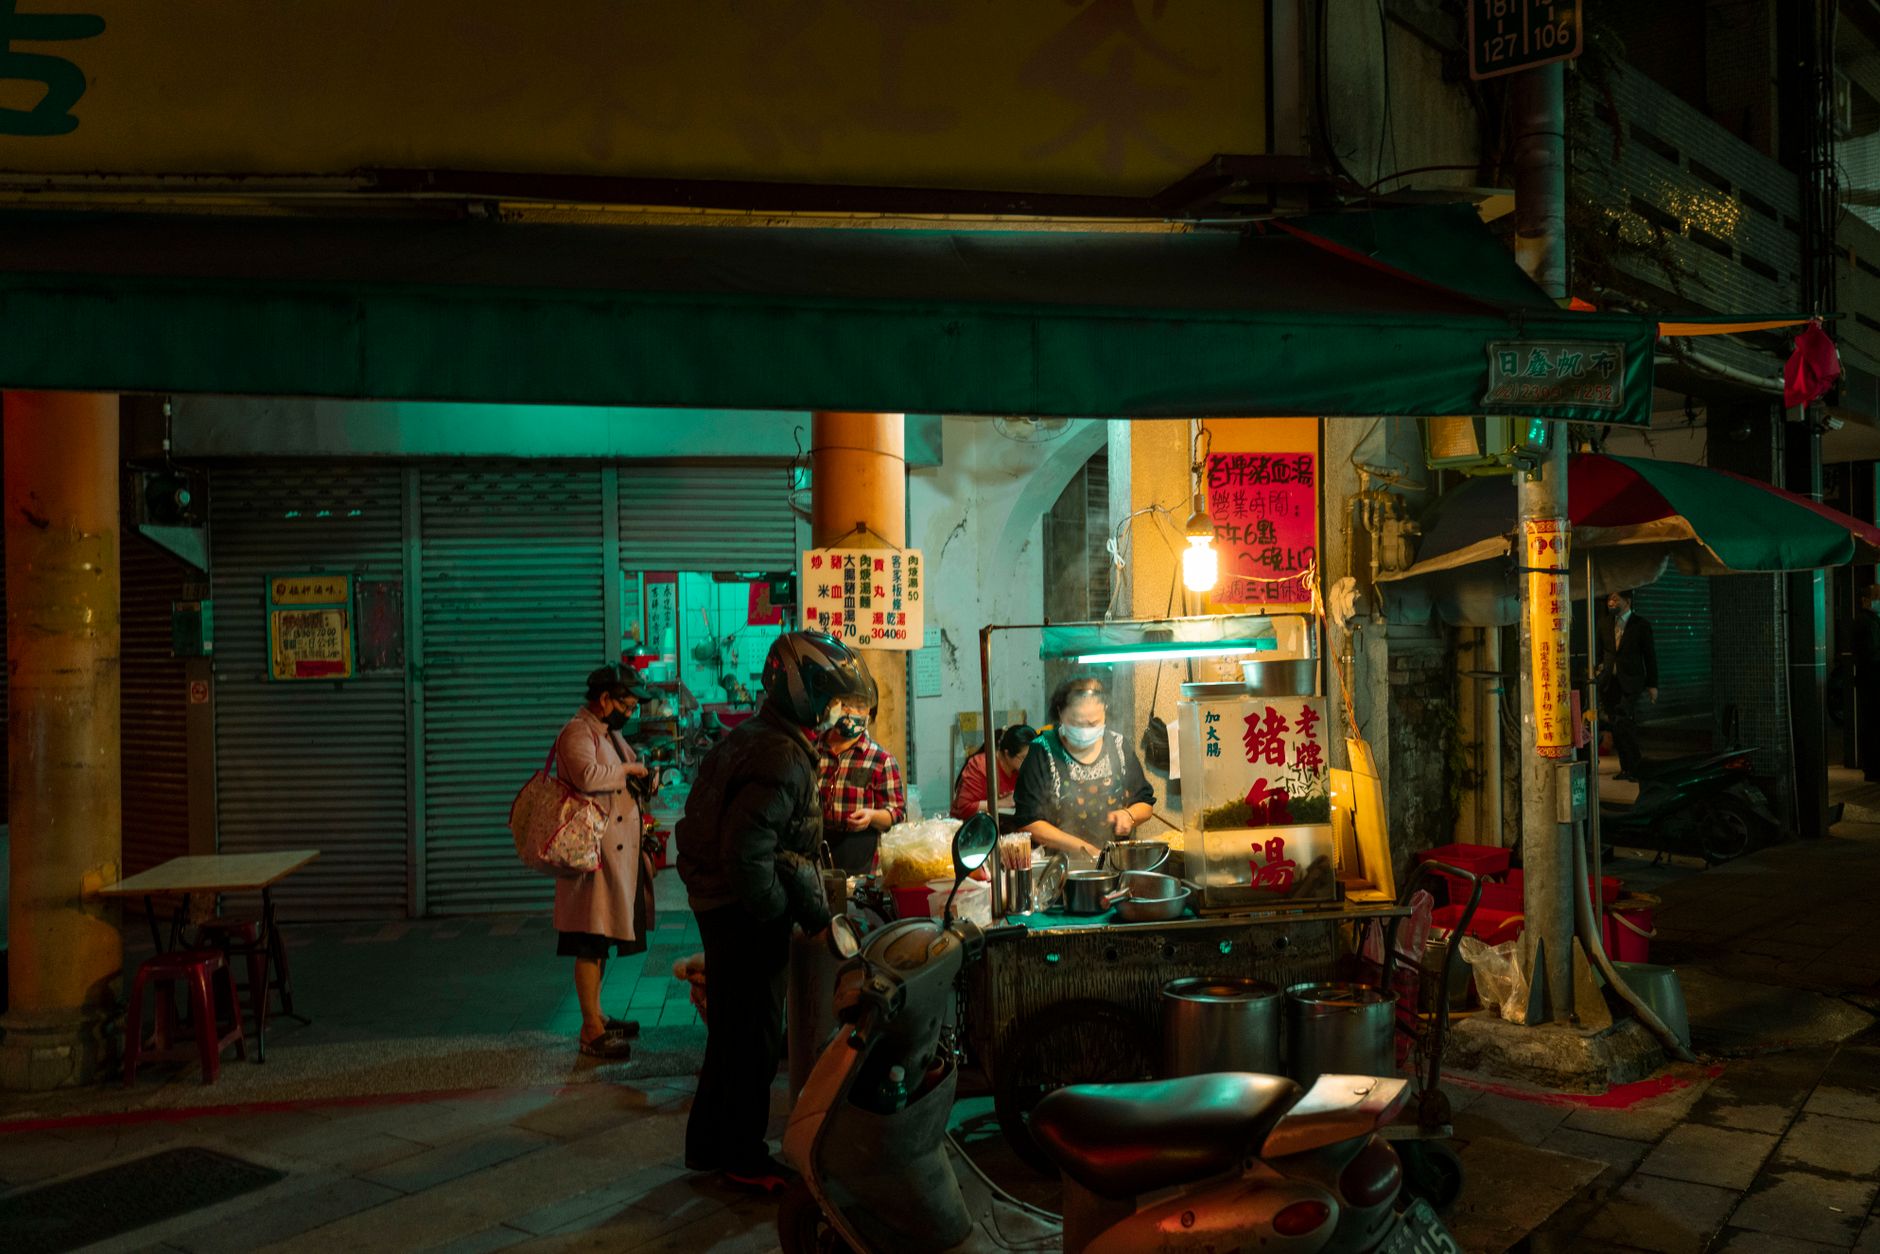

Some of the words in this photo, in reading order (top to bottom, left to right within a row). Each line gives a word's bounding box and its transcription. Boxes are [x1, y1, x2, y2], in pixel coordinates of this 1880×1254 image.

[1483, 32, 1518, 65] 127
[1534, 20, 1570, 51] 106
[908, 591, 919, 601] 50
[843, 624, 857, 637] 70
[859, 635, 870, 645] 60
[871, 628, 884, 639] 30
[1205, 711, 1221, 757] 加大腸
[1294, 705, 1323, 778] 老牌
[1242, 706, 1296, 894] 豬血湯
